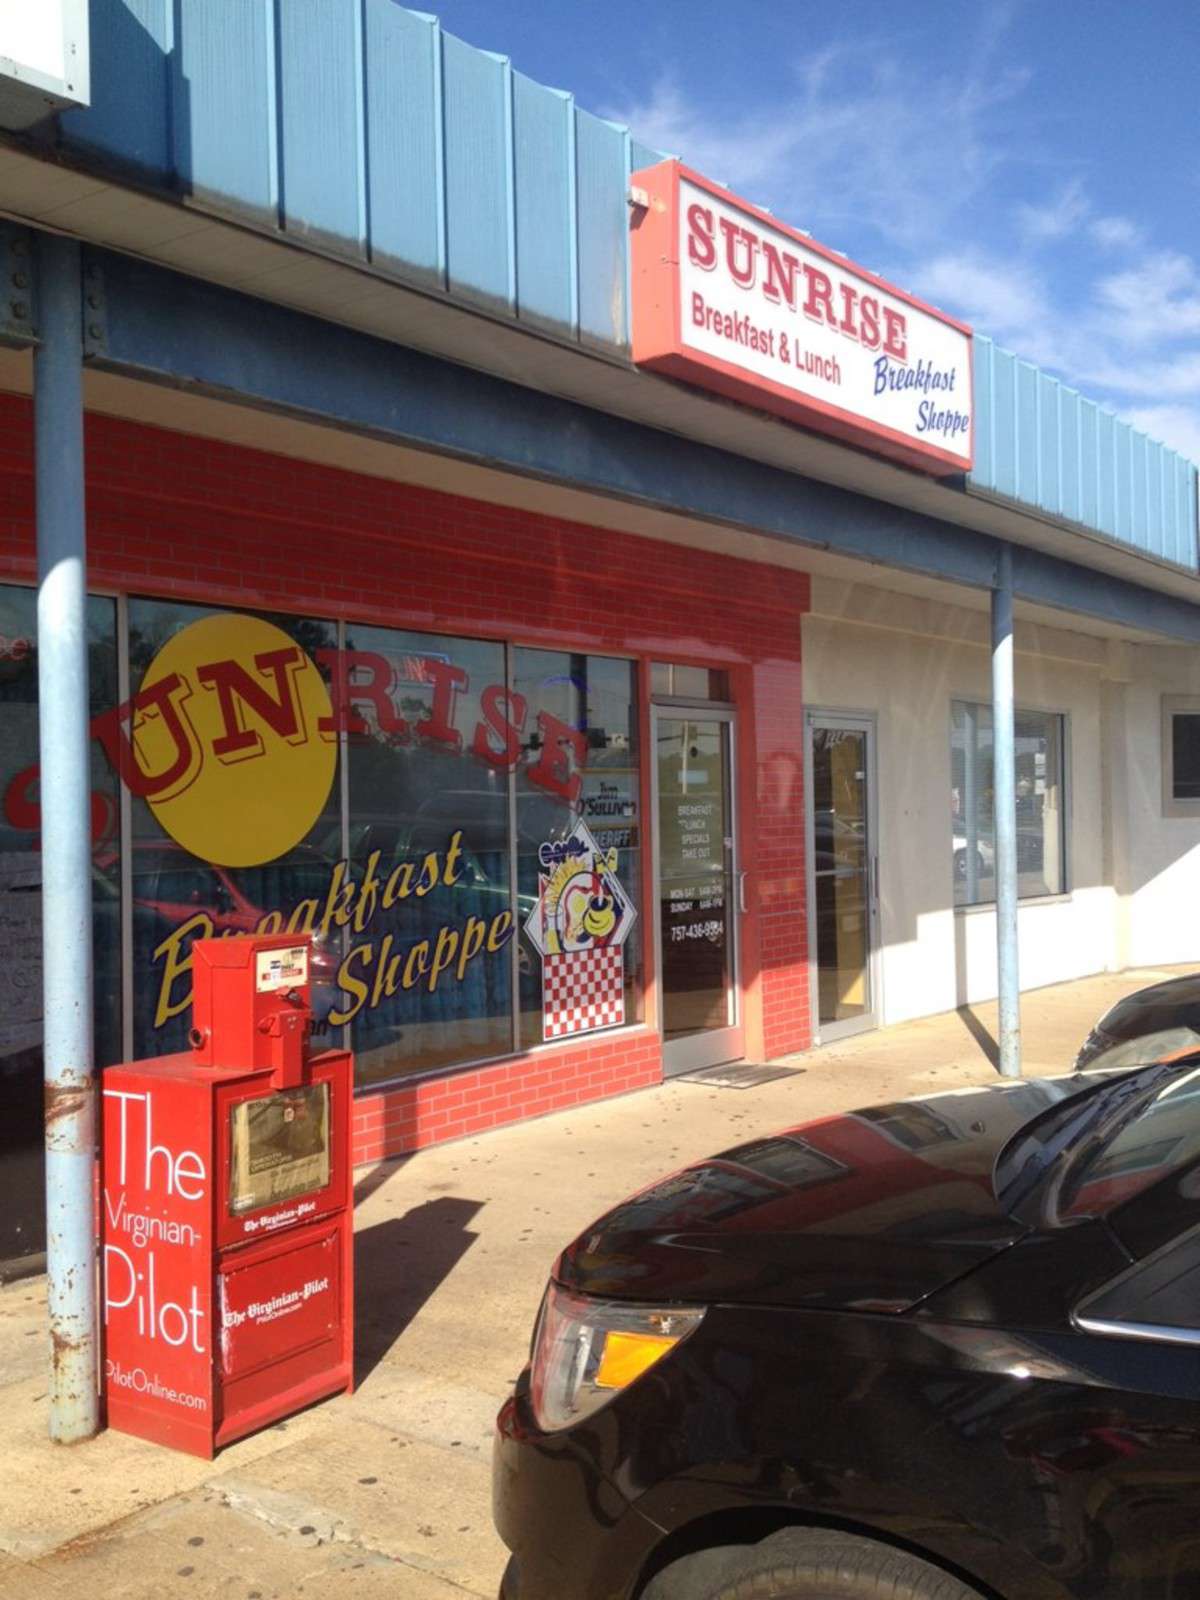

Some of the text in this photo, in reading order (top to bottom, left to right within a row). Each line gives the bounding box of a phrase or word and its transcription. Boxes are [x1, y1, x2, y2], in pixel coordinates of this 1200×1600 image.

[687, 203, 908, 364] SUNRISE
[692, 291, 842, 385] Breakfast & Lunch
[873, 355, 957, 396] Breakfast
[916, 400, 969, 438] Shoppe
[591, 829, 631, 847] HERIFF
[152, 831, 462, 1029] Beakfast
[327, 910, 514, 1027] Shoppe
[103, 1090, 206, 1201] The
[104, 1188, 202, 1248] Virginian-
[104, 1244, 207, 1354] Pilot
[246, 1277, 329, 1319] Virginian-Pilot
